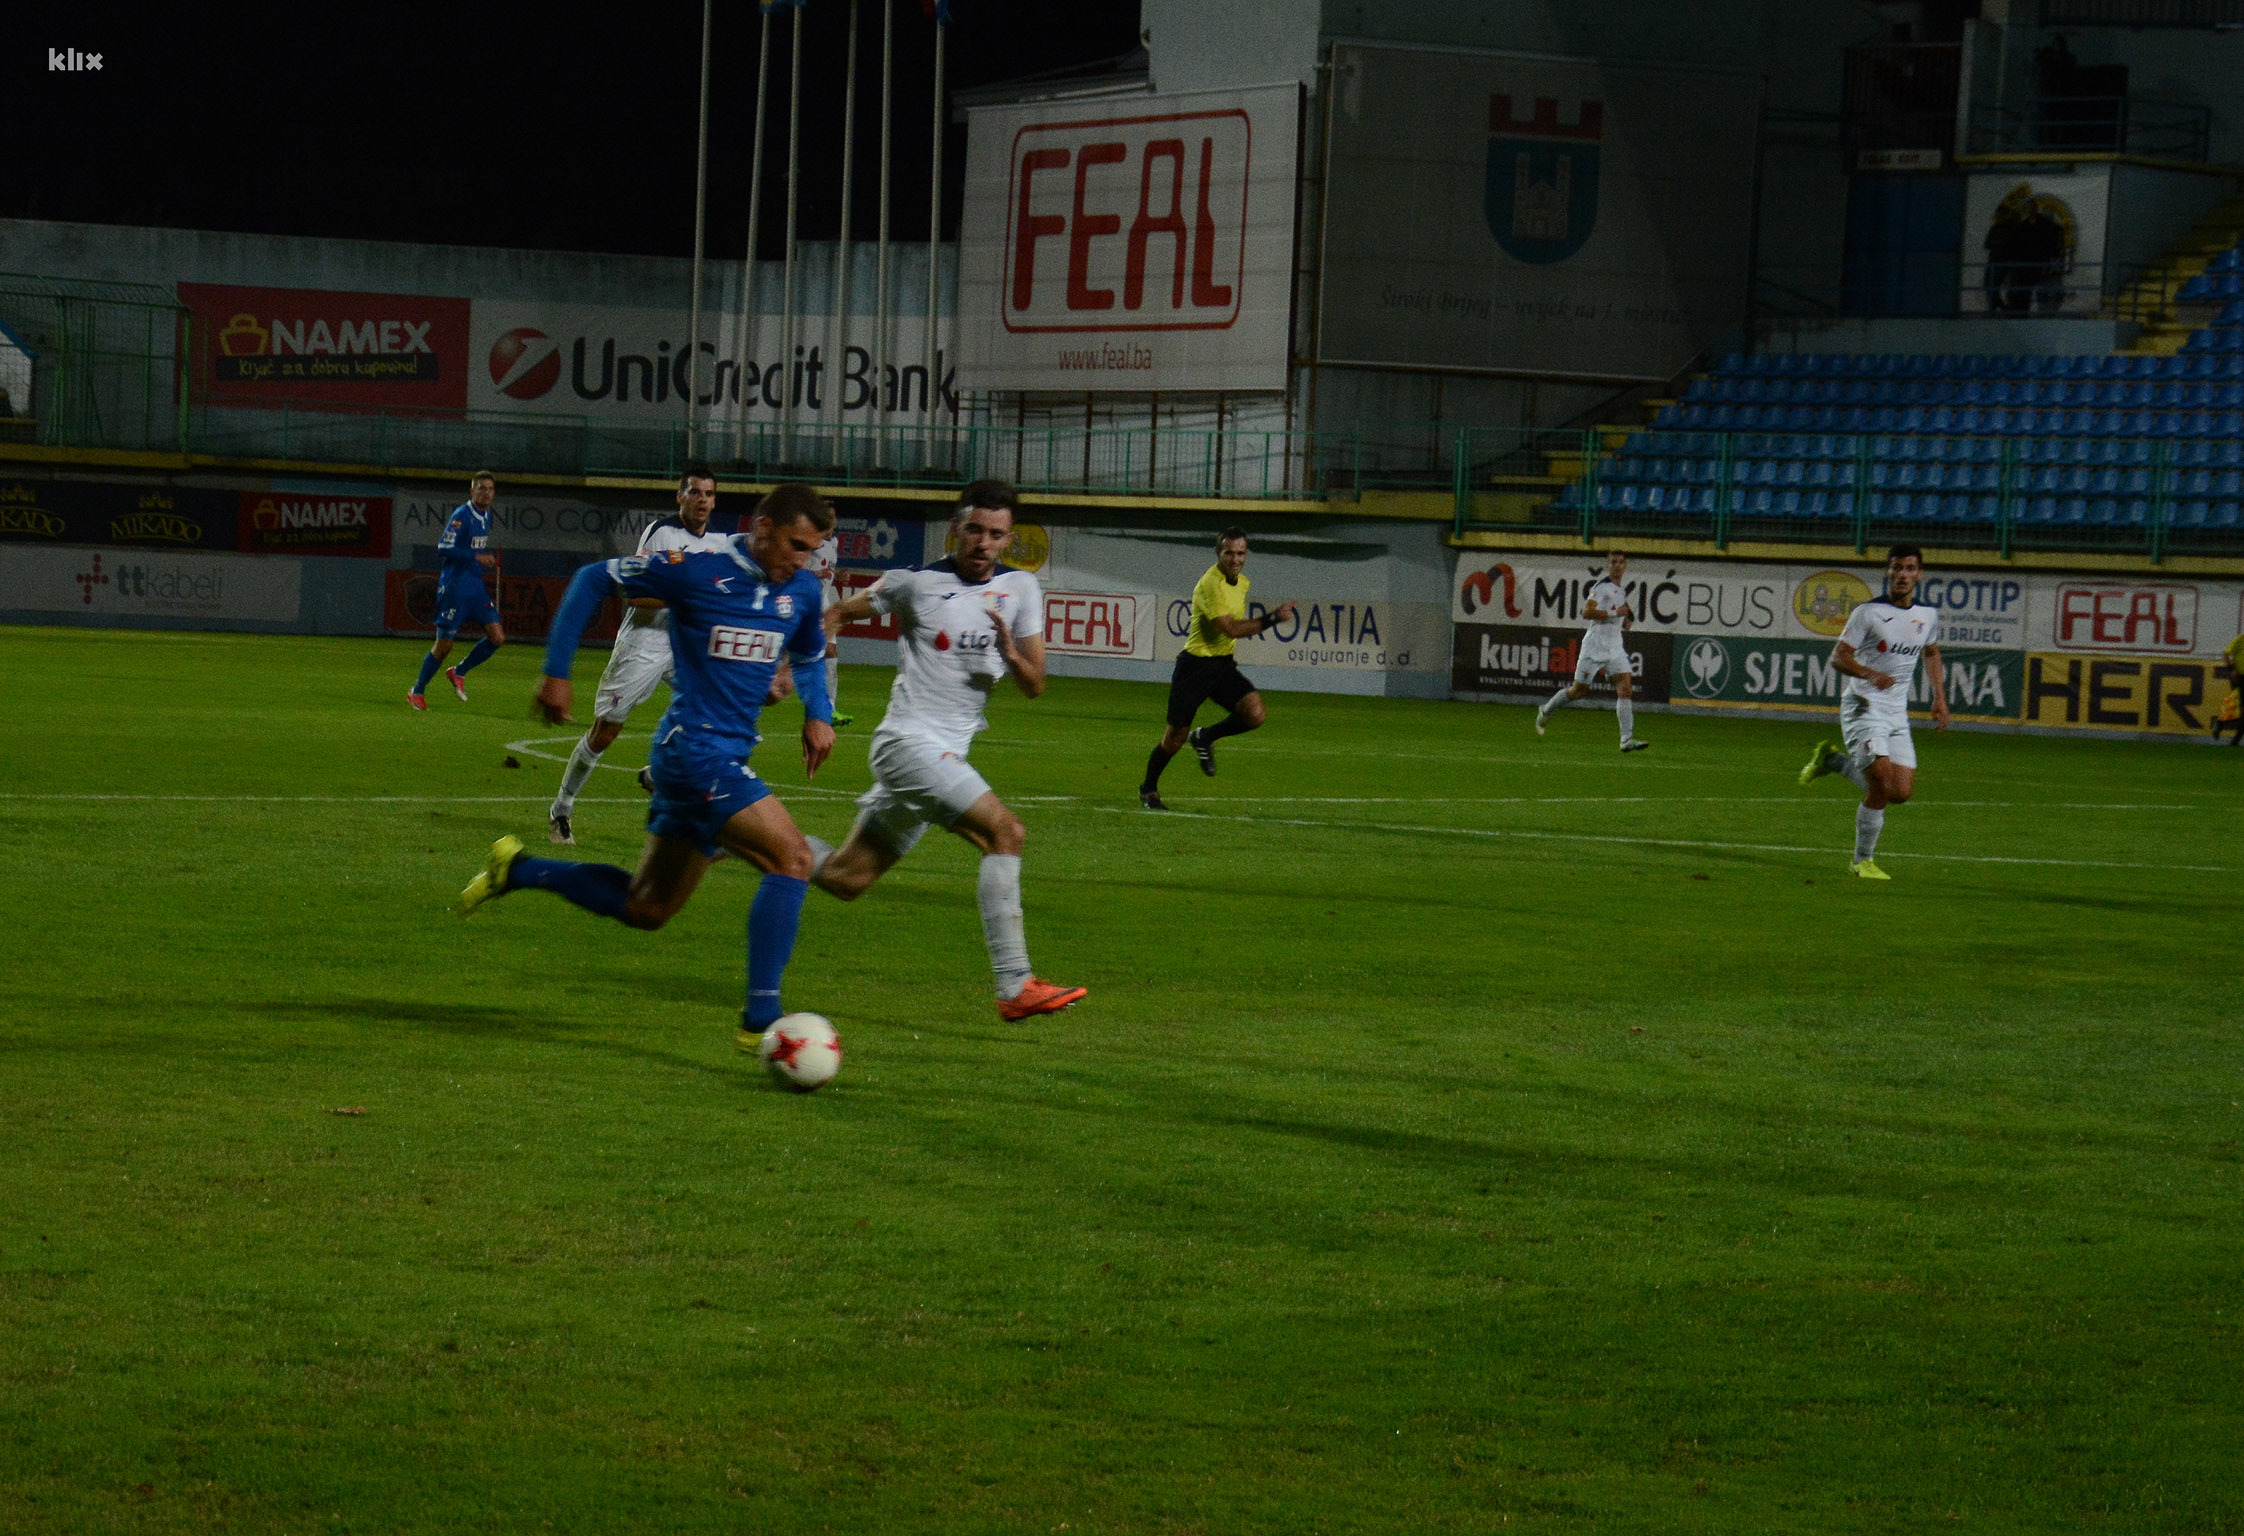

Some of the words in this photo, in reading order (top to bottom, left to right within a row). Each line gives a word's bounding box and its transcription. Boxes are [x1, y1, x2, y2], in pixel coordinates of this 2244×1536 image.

[1012, 137, 1233, 311] FEAL
[271, 319, 434, 355] NAMEX
[282, 362, 305, 377] za
[311, 358, 350, 376] dobru
[1058, 342, 1152, 370] www.feal.ba
[571, 336, 824, 410] UniCredit
[842, 346, 957, 413] Bank
[0, 508, 67, 536] KADO
[110, 515, 202, 542] MIKADO
[280, 502, 368, 529] NAMEX
[404, 502, 544, 532] ANNIO
[116, 564, 222, 600] ttkabeli
[486, 583, 549, 611] LTA
[1882, 577, 2020, 612] GOTIP
[1044, 599, 1130, 648] FEAL
[1245, 602, 1380, 646] ROATIA
[2061, 589, 2189, 646] FEAL
[714, 629, 776, 660] FEAL
[1949, 627, 2002, 643] BRIJEG
[1288, 648, 1370, 667] osiguranje
[1743, 650, 2006, 708] SJEMNA
[2027, 657, 2235, 730] HER
